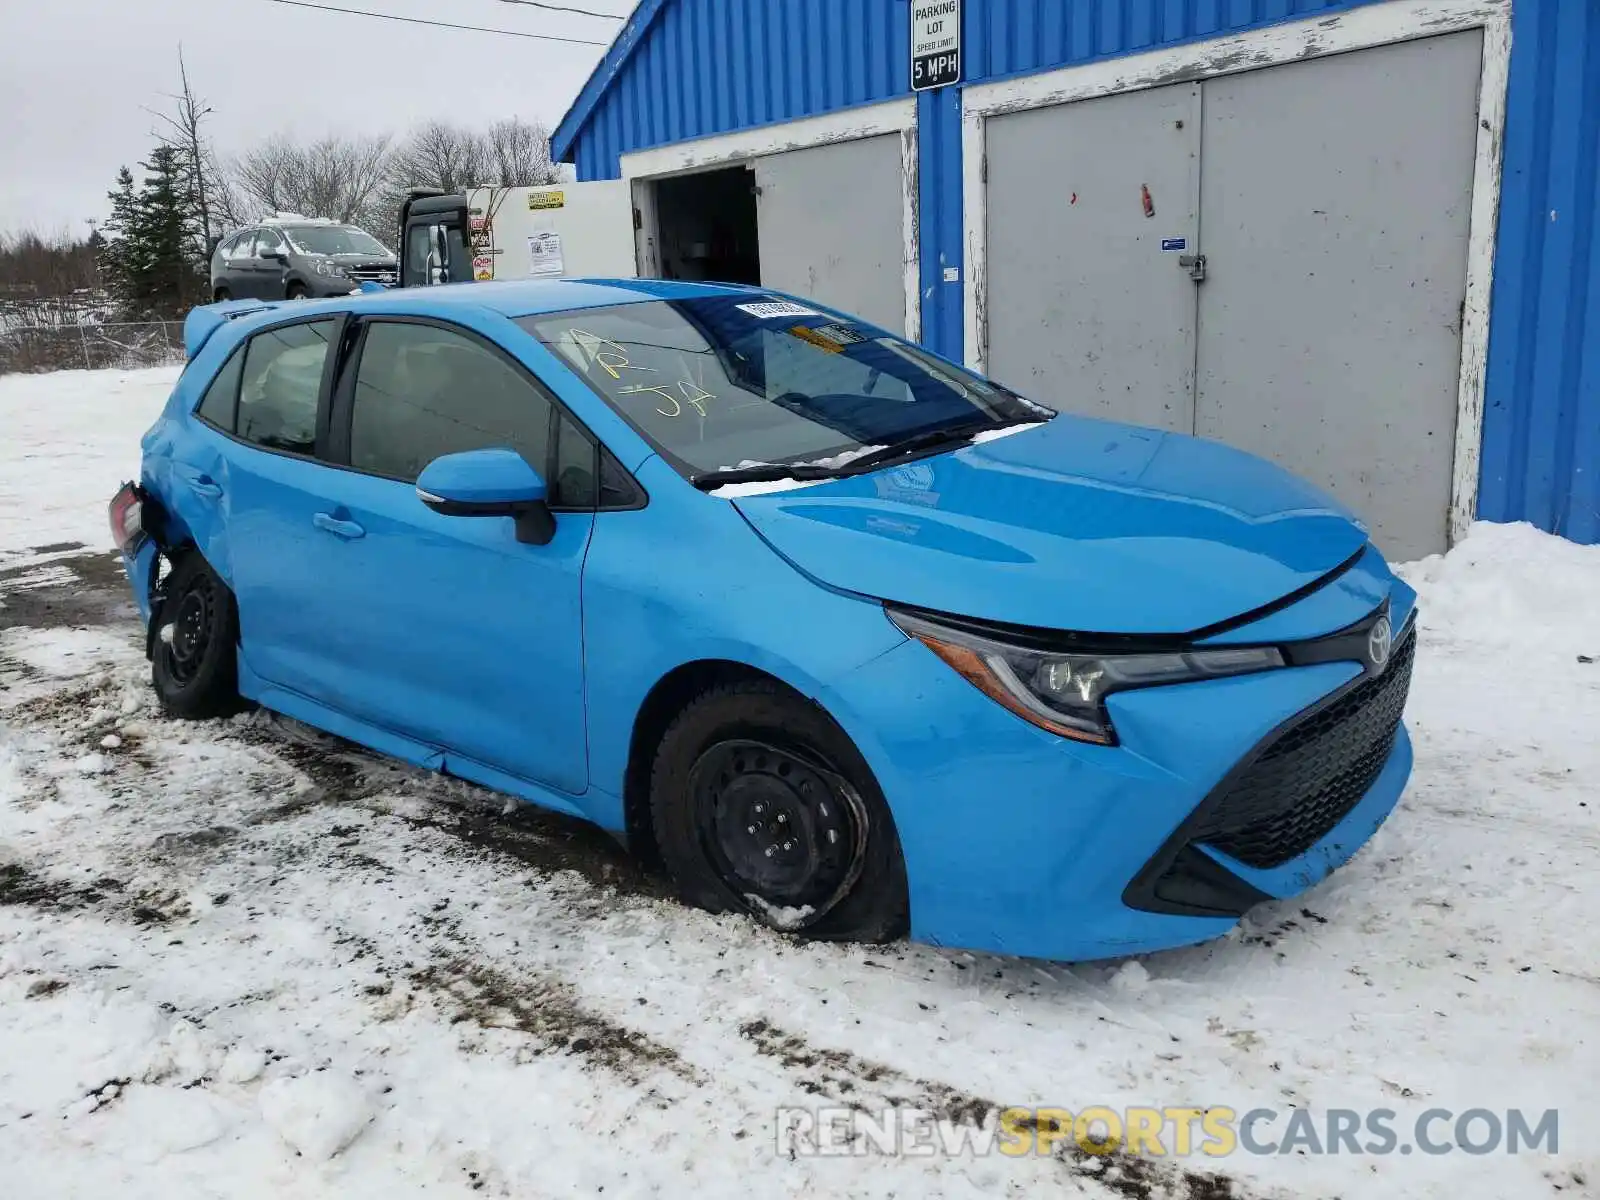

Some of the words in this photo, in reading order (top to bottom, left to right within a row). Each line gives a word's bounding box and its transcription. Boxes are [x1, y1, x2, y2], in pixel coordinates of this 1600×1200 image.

[916, 1, 955, 20] PARKING
[927, 21, 943, 35] LOT
[917, 41, 936, 52] SPEED
[938, 36, 954, 48] LIMIT
[915, 61, 923, 79] 5
[928, 54, 957, 76] MPH
